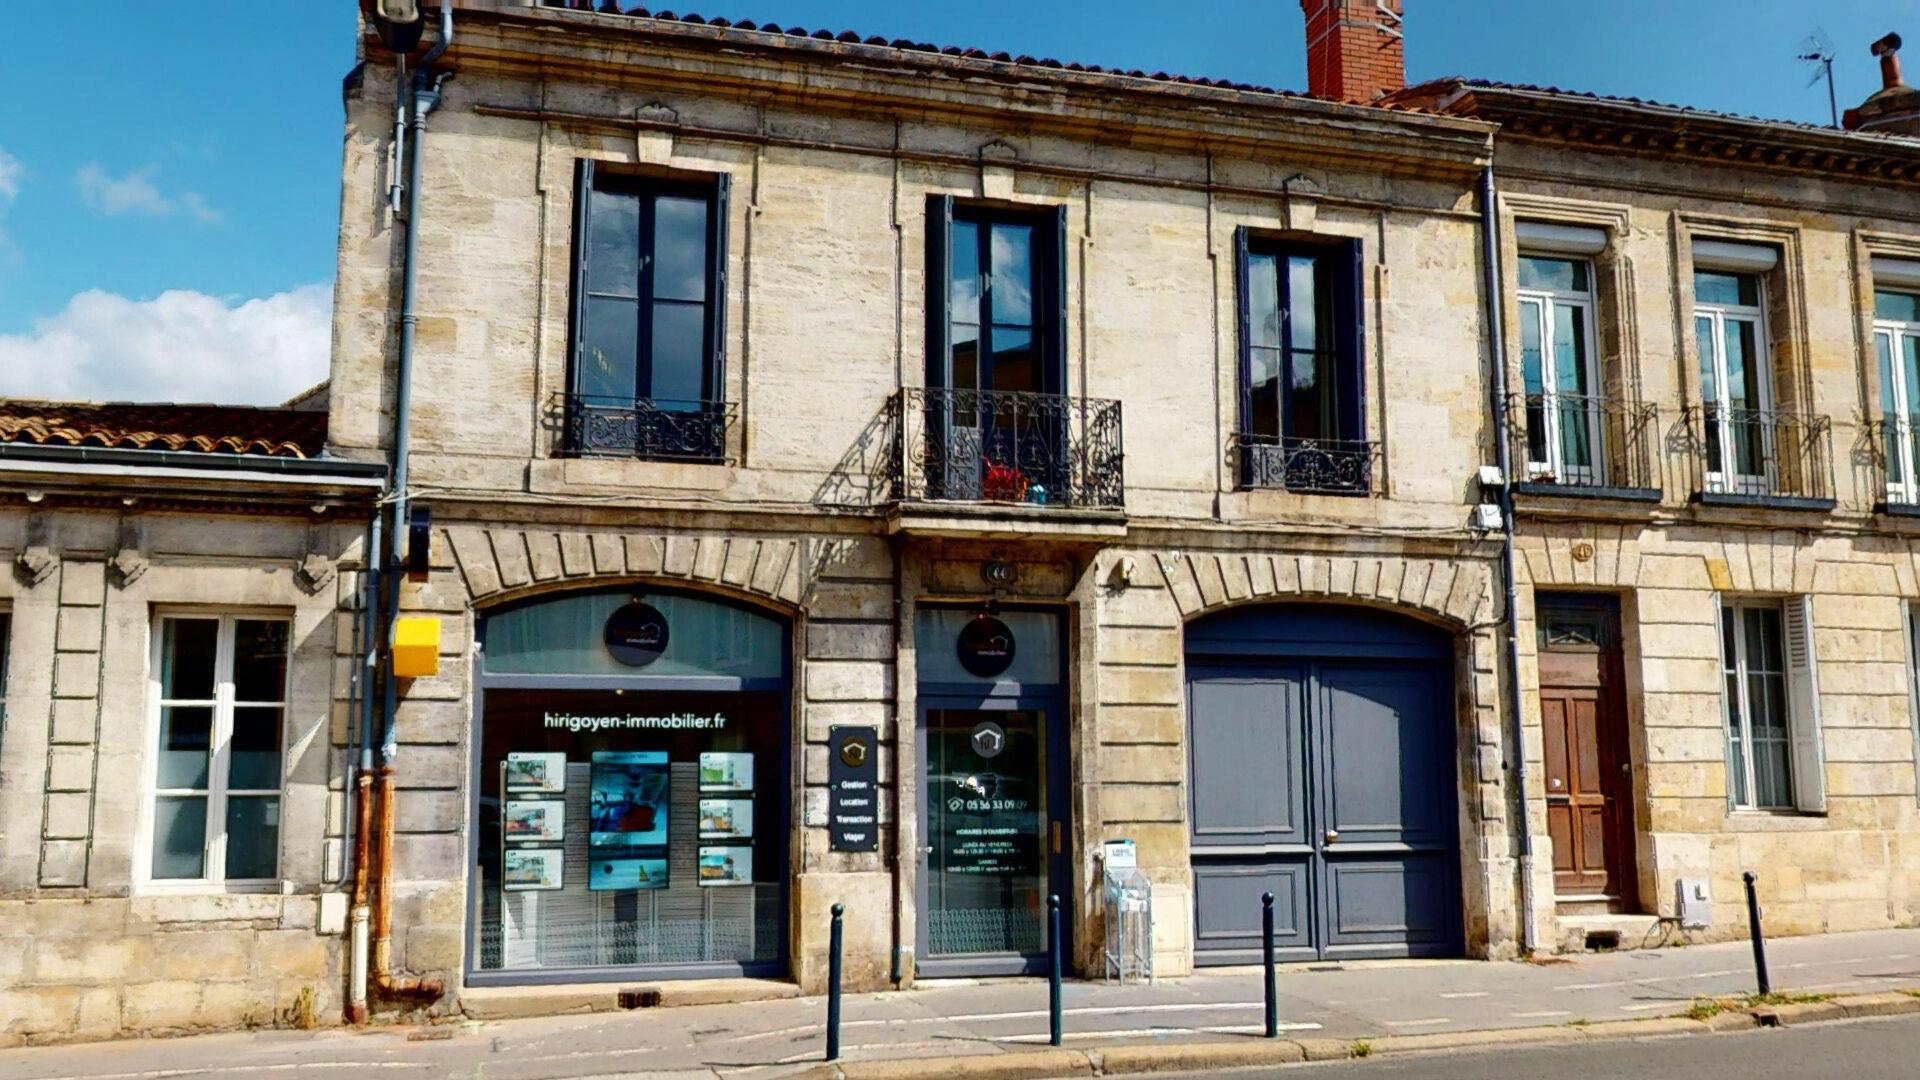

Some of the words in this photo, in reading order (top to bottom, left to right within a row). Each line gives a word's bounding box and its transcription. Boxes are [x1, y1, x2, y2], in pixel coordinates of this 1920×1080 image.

[544, 712, 726, 732] hirigoyen-immobilier.fr
[841, 781, 868, 789] Gestion
[840, 798, 868, 806] Location
[966, 800, 978, 810] 05
[979, 800, 991, 810] 56
[992, 800, 1003, 810] 33
[1004, 799, 1015, 810] 09
[836, 815, 873, 824] Transaction
[843, 833, 865, 843] Viager
